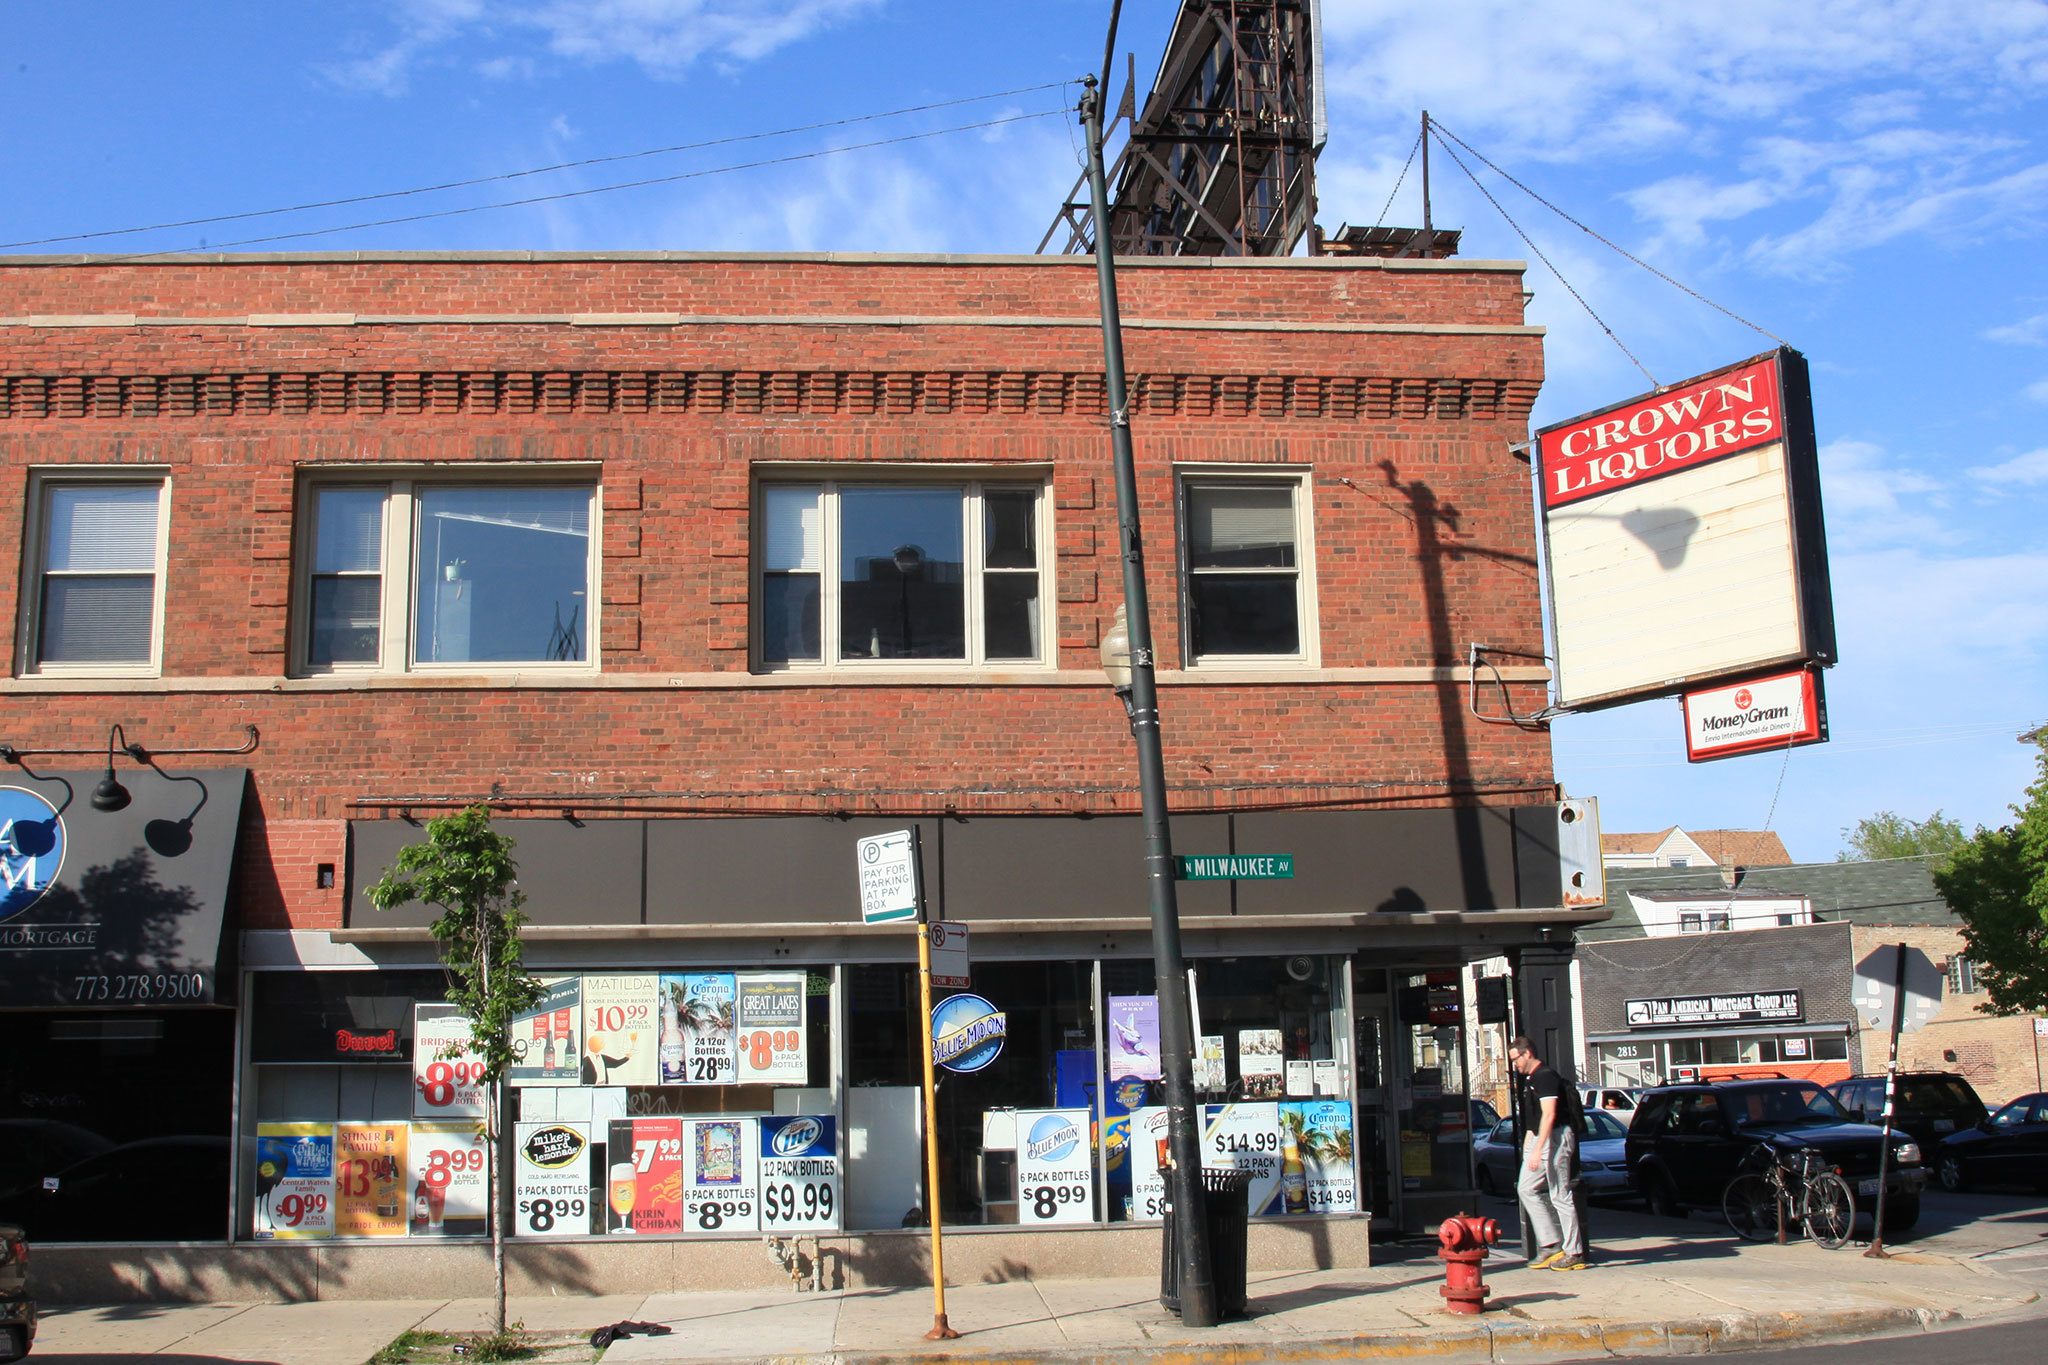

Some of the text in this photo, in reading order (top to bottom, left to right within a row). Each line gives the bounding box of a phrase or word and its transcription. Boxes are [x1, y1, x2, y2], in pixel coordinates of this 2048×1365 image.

[1561, 375, 1757, 457] CROWN
[1553, 406, 1773, 495] LIQUORS
[1702, 705, 1788, 732] MoneyGram
[1722, 727, 1760, 740] Internacional
[1770, 722, 1790, 731] Dinero
[864, 864, 905, 879] PAY FOR
[1185, 858, 1289, 876] N MILWAUKEE AV
[865, 874, 909, 890] PARKING
[867, 887, 900, 900] AT PAY
[867, 900, 886, 911] BOX
[75, 973, 203, 1000] 773 278.9500
[588, 978, 653, 990] MATILDA
[933, 976, 966, 986] TOW ZONE
[551, 987, 579, 1001] FAMILY
[691, 983, 729, 995] Corona
[743, 995, 799, 1010] GREAT LAKES
[1782, 994, 1797, 1008] LLC
[336, 1029, 395, 1051] Duvel
[695, 1037, 726, 1046] 24 12oz
[932, 1016, 1004, 1065] BLUE MOON
[694, 1047, 726, 1055] Bottles
[1617, 1046, 1638, 1057] 2815
[1309, 1113, 1346, 1125] Corona
[342, 1132, 380, 1141] SHINER
[533, 1132, 571, 1146] mike's
[783, 1127, 816, 1152] Lite
[1028, 1127, 1078, 1159] BLUE MOON
[1216, 1132, 1277, 1154] $14.99
[343, 1143, 379, 1152] FAMILY
[534, 1146, 578, 1163] lemonade
[544, 1142, 569, 1153] hard
[764, 1160, 835, 1176] 12 PACK BOTTLES
[1239, 1158, 1275, 1168] 12 PACK
[1021, 1170, 1090, 1183] 6 PACK BOTTLES
[1252, 1169, 1269, 1179] ANS
[518, 1185, 588, 1195] 6 PACK BOTTLES
[685, 1188, 755, 1200] 6 PACK BOTTLES
[1137, 1185, 1141, 1193] 6
[765, 1181, 834, 1225] $9.99
[1310, 1189, 1352, 1205] $14.99
[635, 1209, 665, 1218] KIRIN
[635, 1219, 681, 1229] ICHIBAN
